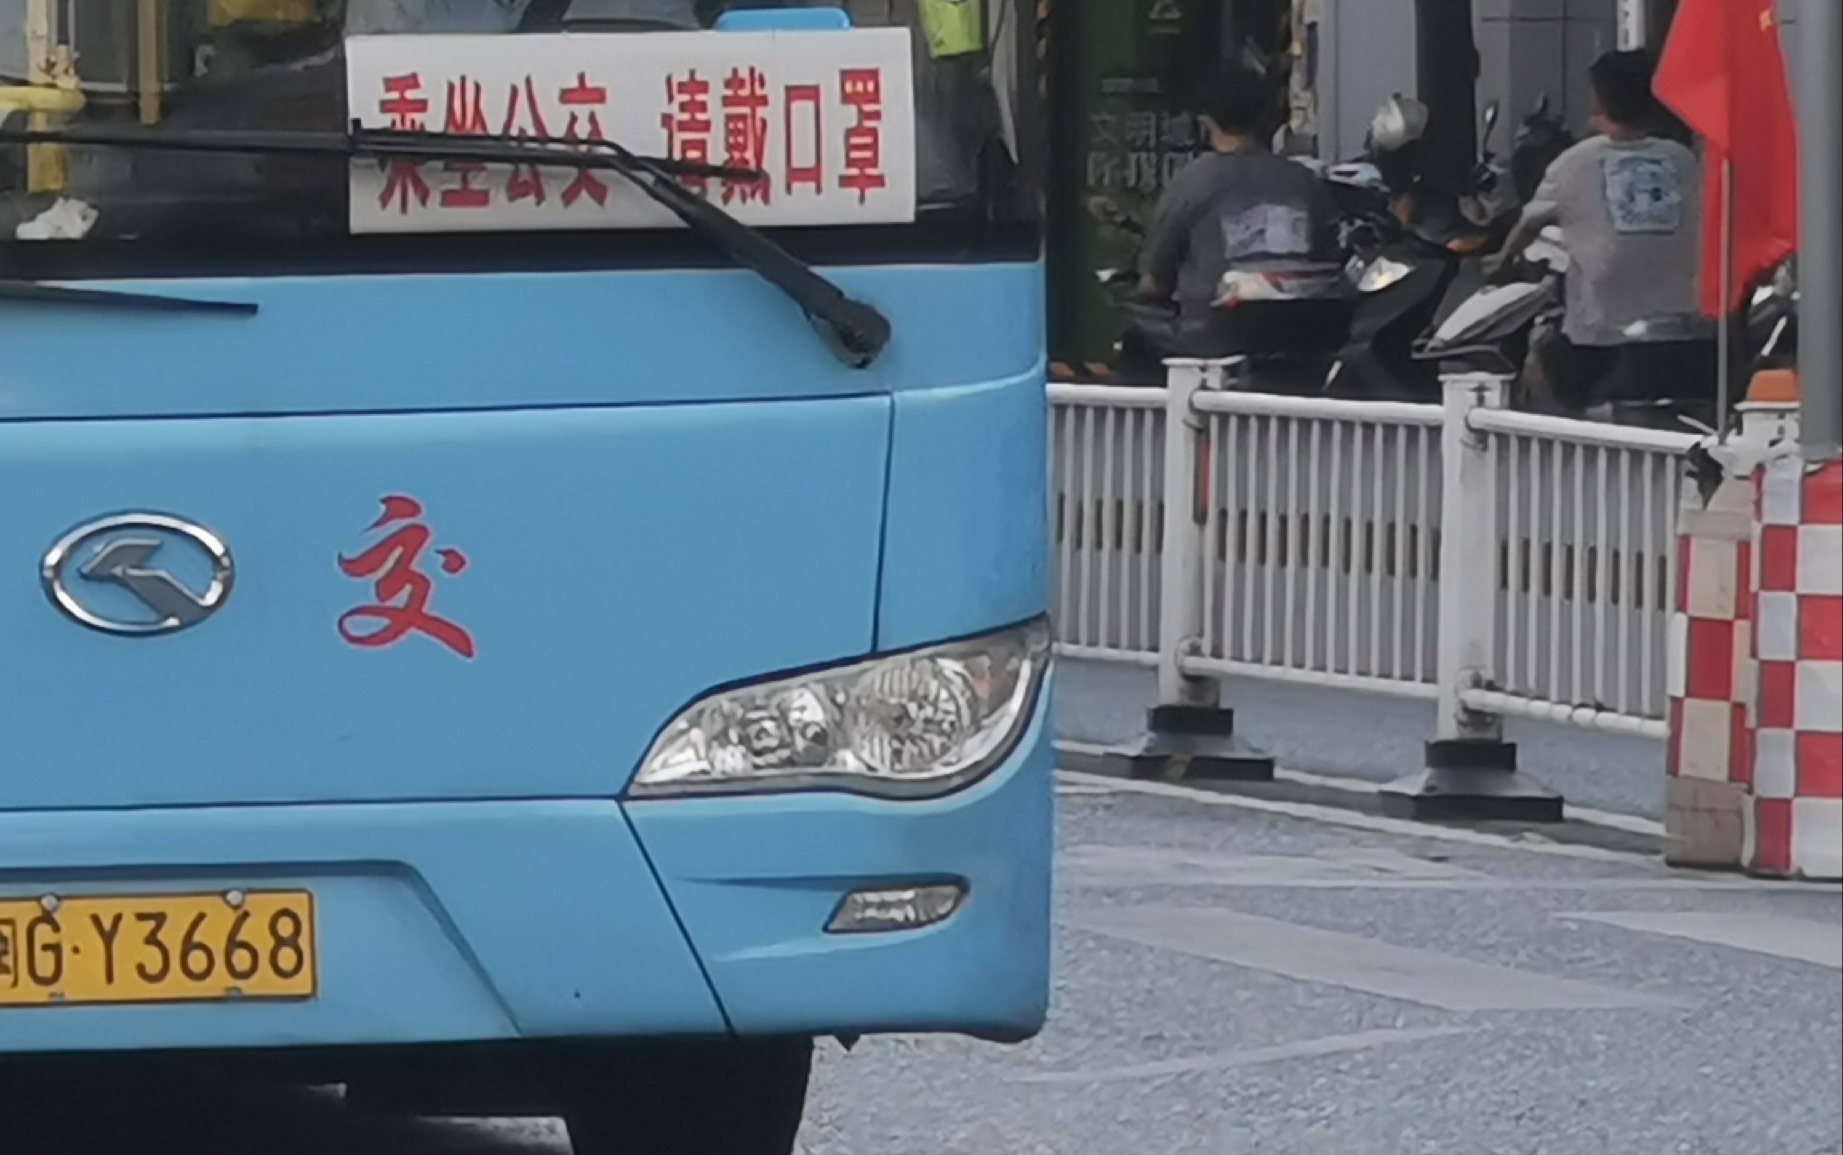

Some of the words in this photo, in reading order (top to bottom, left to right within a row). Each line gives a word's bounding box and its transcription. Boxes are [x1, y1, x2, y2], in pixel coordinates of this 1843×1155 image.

[659, 66, 887, 206] 请戴口罩
[337, 494, 476, 659] 交
